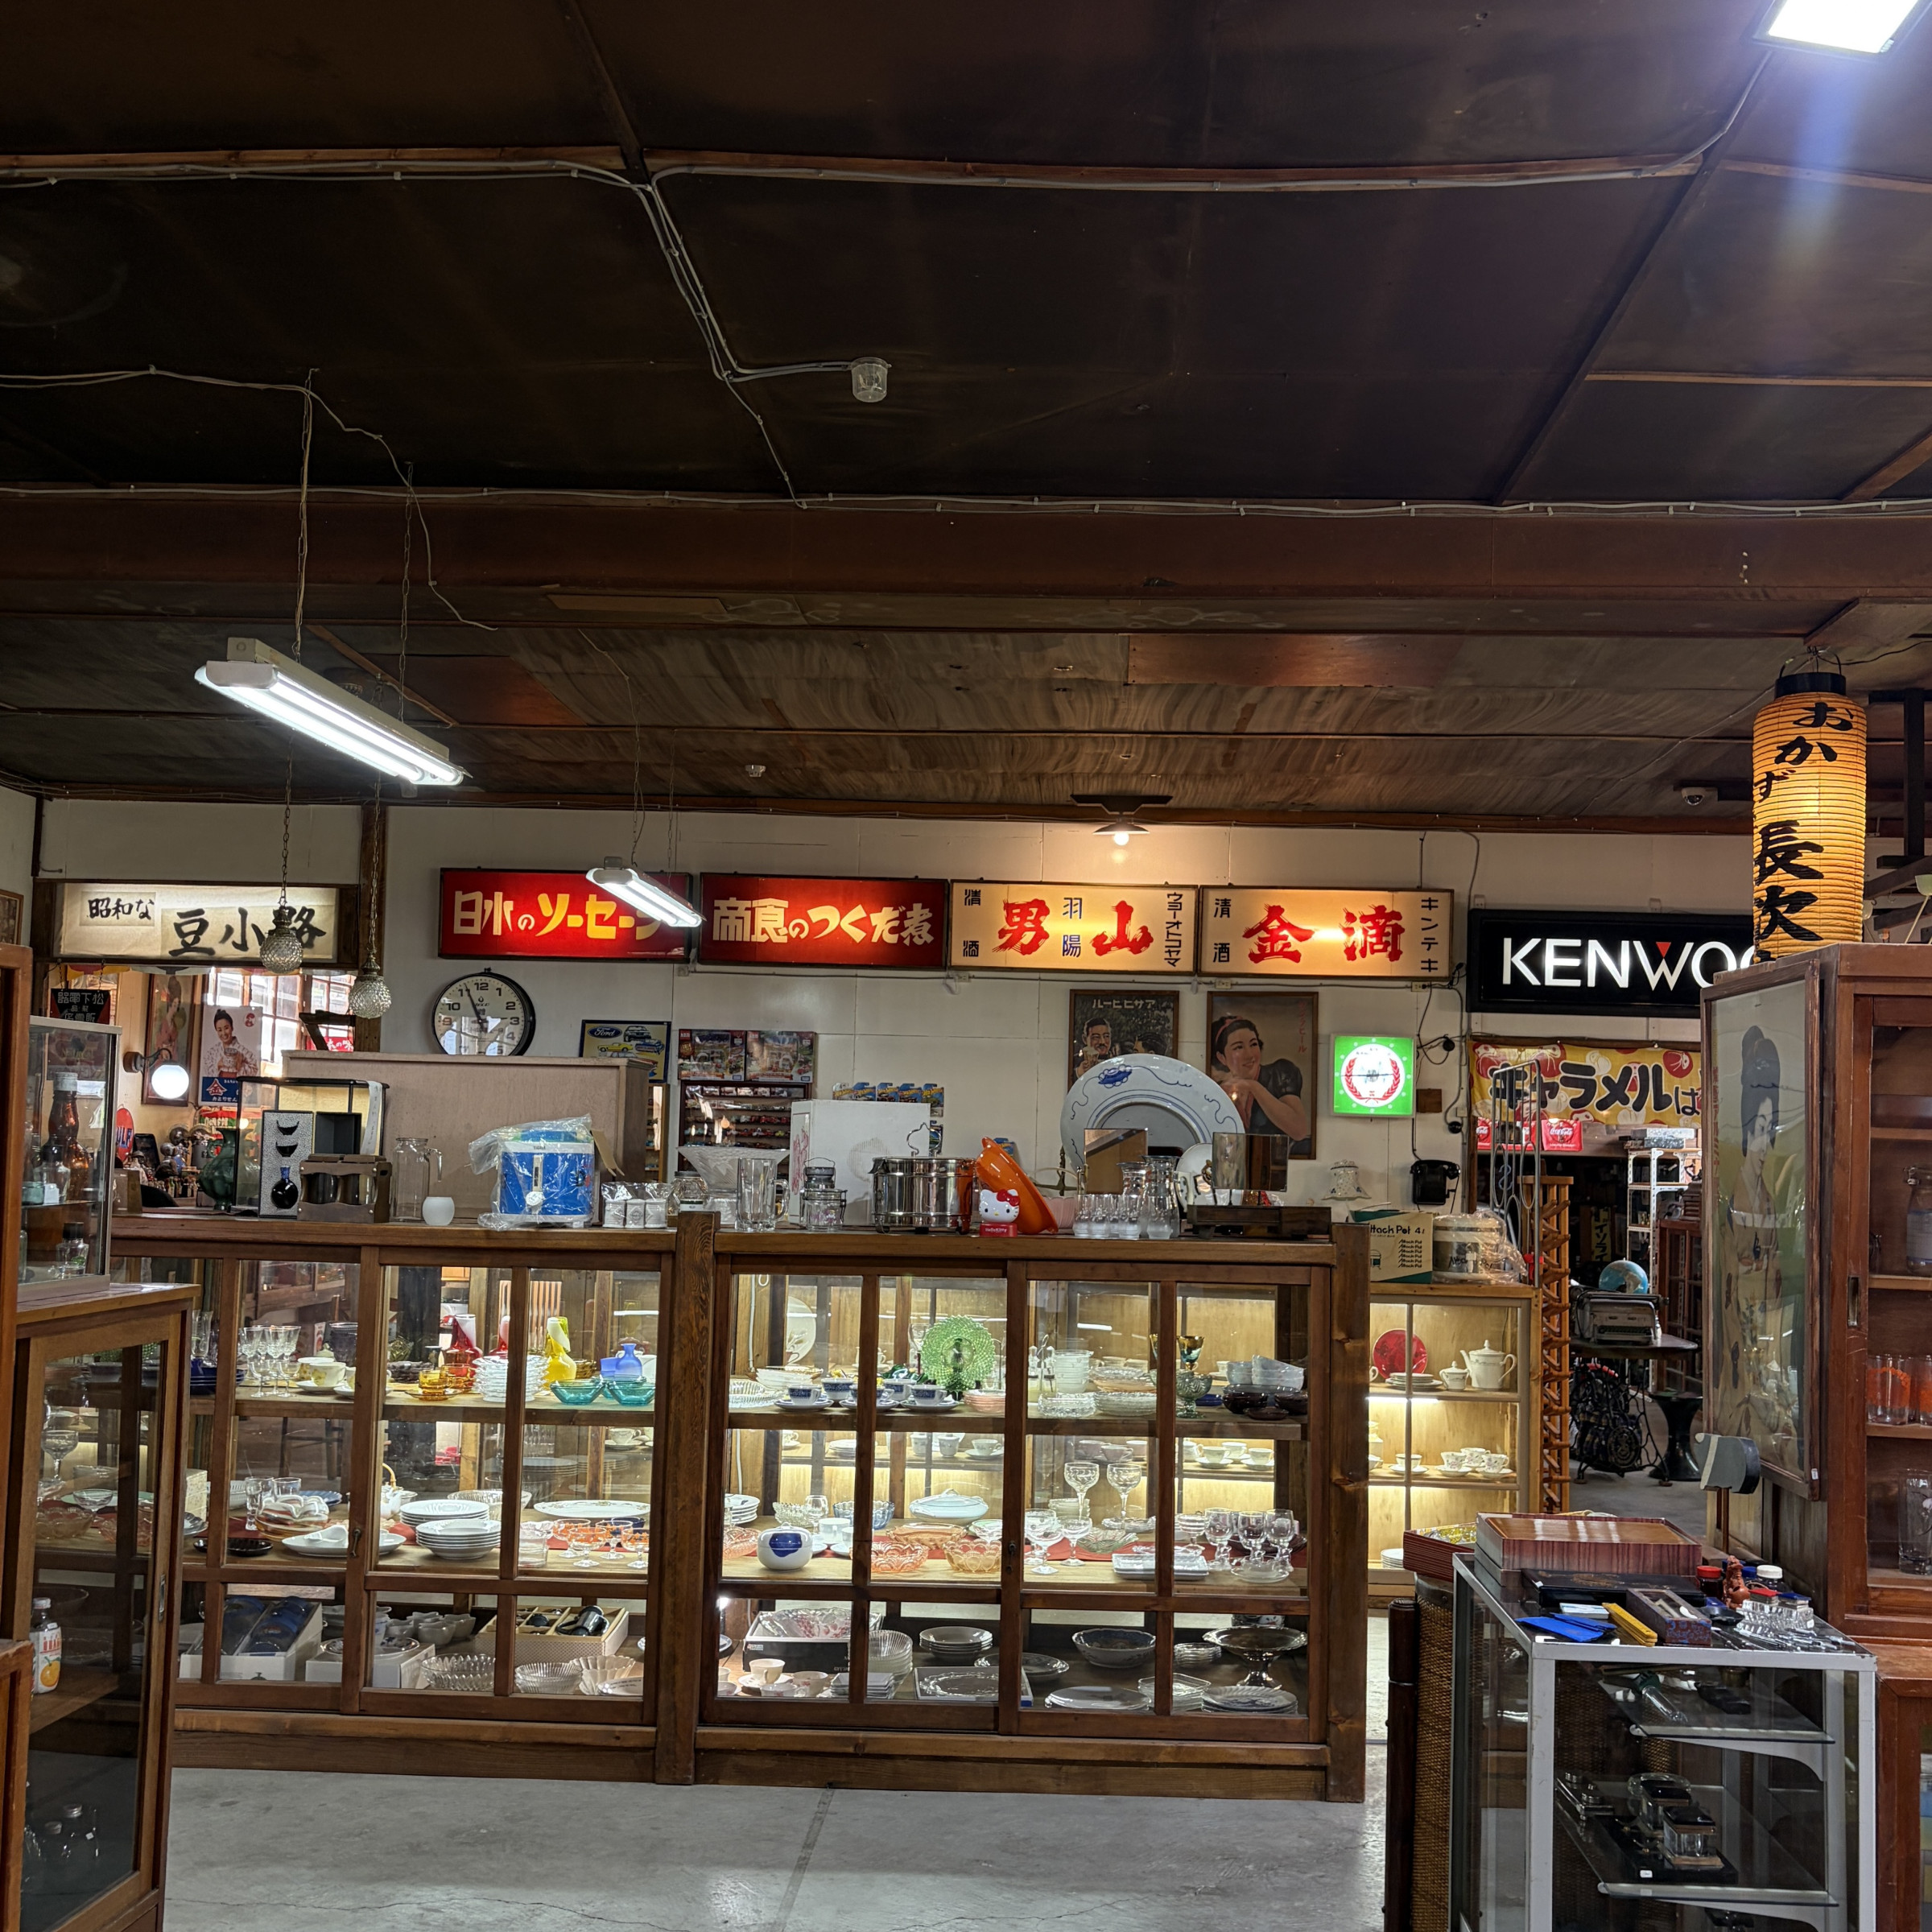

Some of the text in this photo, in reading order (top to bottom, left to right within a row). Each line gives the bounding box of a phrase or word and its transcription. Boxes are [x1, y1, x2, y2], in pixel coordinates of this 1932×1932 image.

[1754, 820, 1825, 961] 長次
[86, 898, 155, 920] 昭和な
[712, 897, 935, 946] 帝食のつくだ煮
[1212, 898, 1232, 963] 清酒
[1242, 904, 1406, 964] 金滴
[1420, 897, 1439, 972] キンテキ
[1502, 937, 1755, 992] KENWO
[473, 982, 489, 991] 12
[496, 987, 502, 997] 1
[446, 1002, 460, 1010] 10
[506, 1001, 516, 1010] 2
[510, 1017, 520, 1026] 3
[594, 1027, 616, 1037] Ford
[116, 1126, 133, 1147] ULF
[1370, 1224, 1394, 1234] ttack
[1396, 1225, 1410, 1235] Pot
